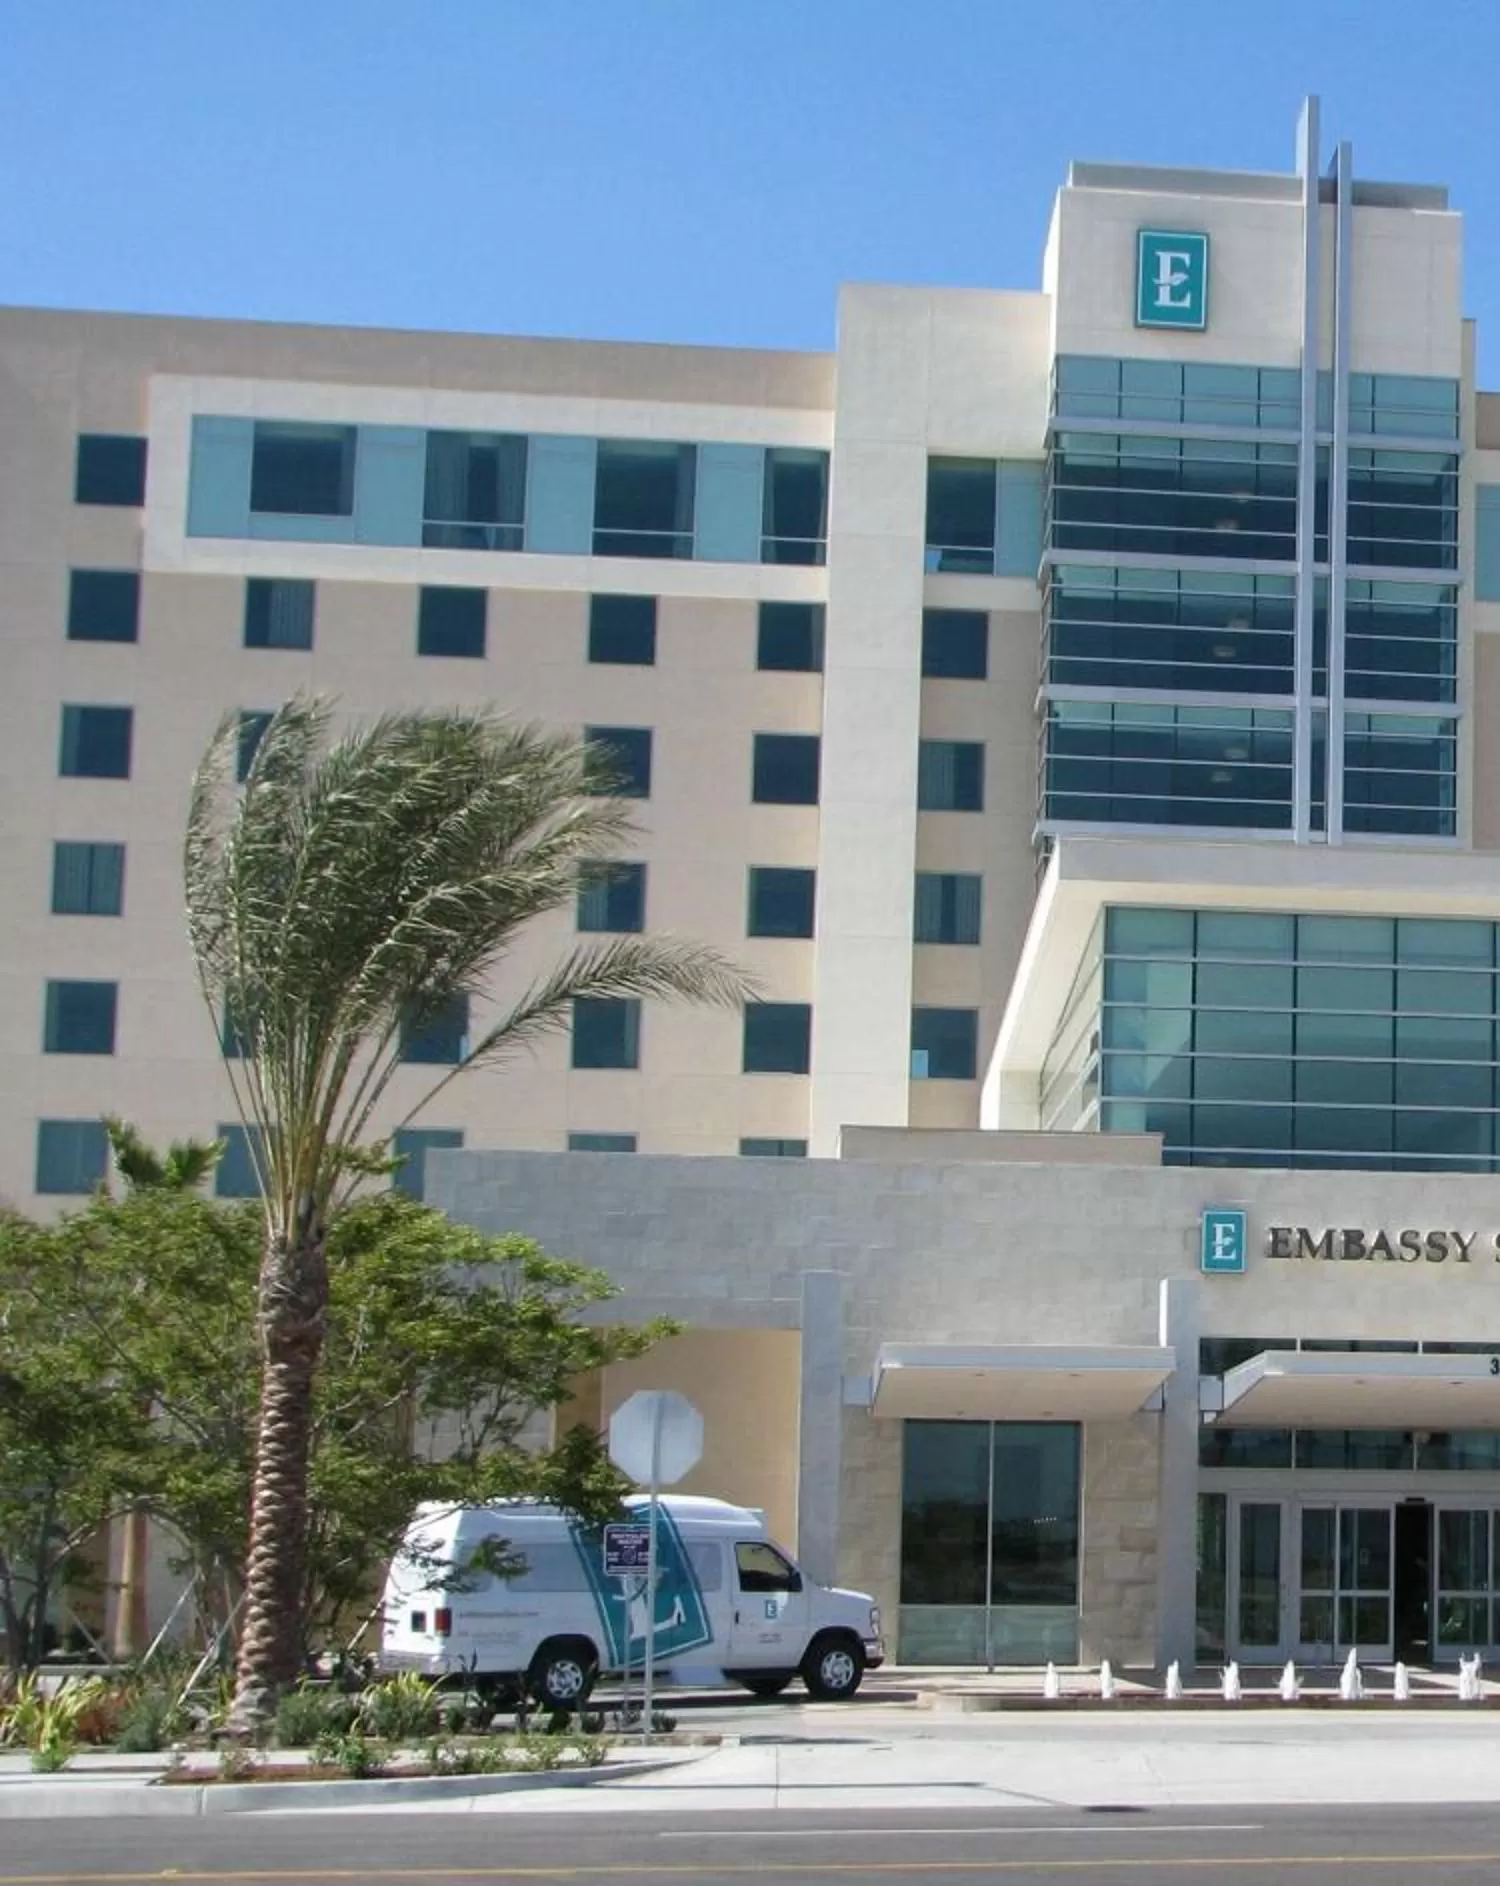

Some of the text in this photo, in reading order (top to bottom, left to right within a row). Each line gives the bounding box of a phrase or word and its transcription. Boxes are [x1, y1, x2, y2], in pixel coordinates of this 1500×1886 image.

[1153, 250, 1192, 308] E
[1213, 1223, 1236, 1260] E
[1267, 1226, 1477, 1263] EMBASSY
